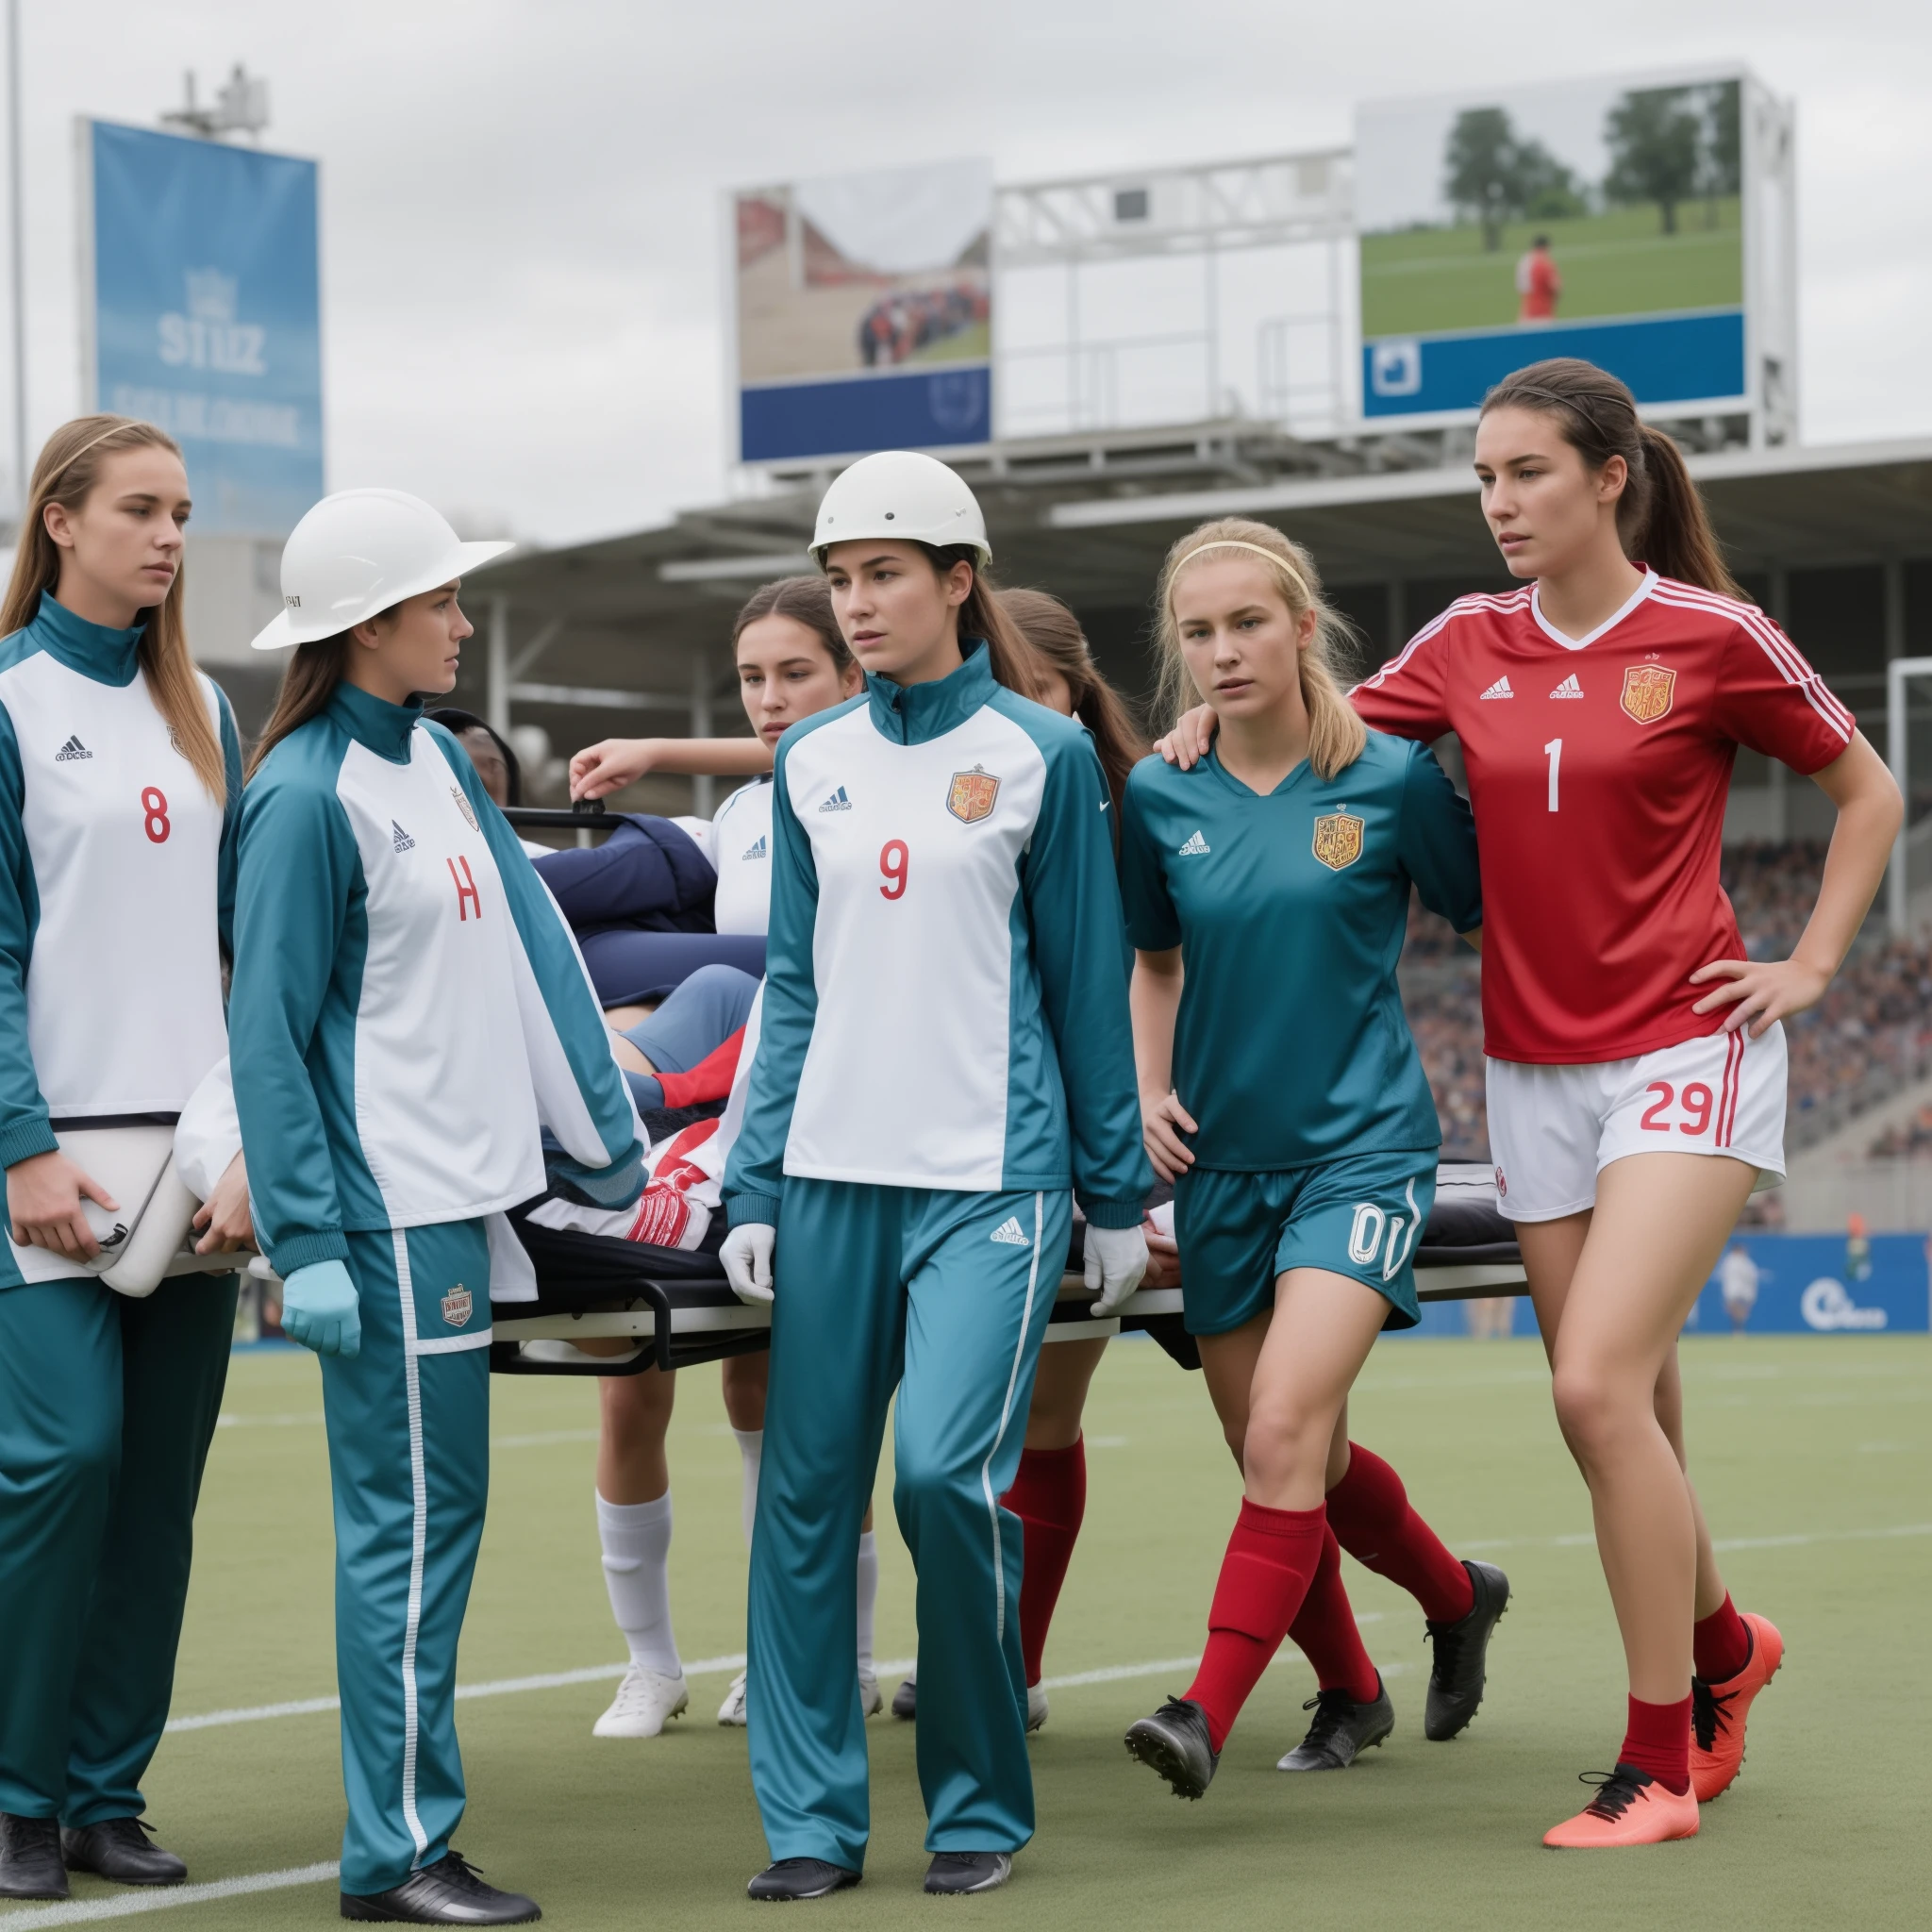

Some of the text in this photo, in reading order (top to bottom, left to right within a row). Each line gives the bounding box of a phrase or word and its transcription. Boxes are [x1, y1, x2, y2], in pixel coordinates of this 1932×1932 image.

[1544, 738, 1563, 812] 1
[141, 786, 171, 844] 8
[879, 839, 909, 901] 9
[1640, 1081, 1714, 1136] 29
